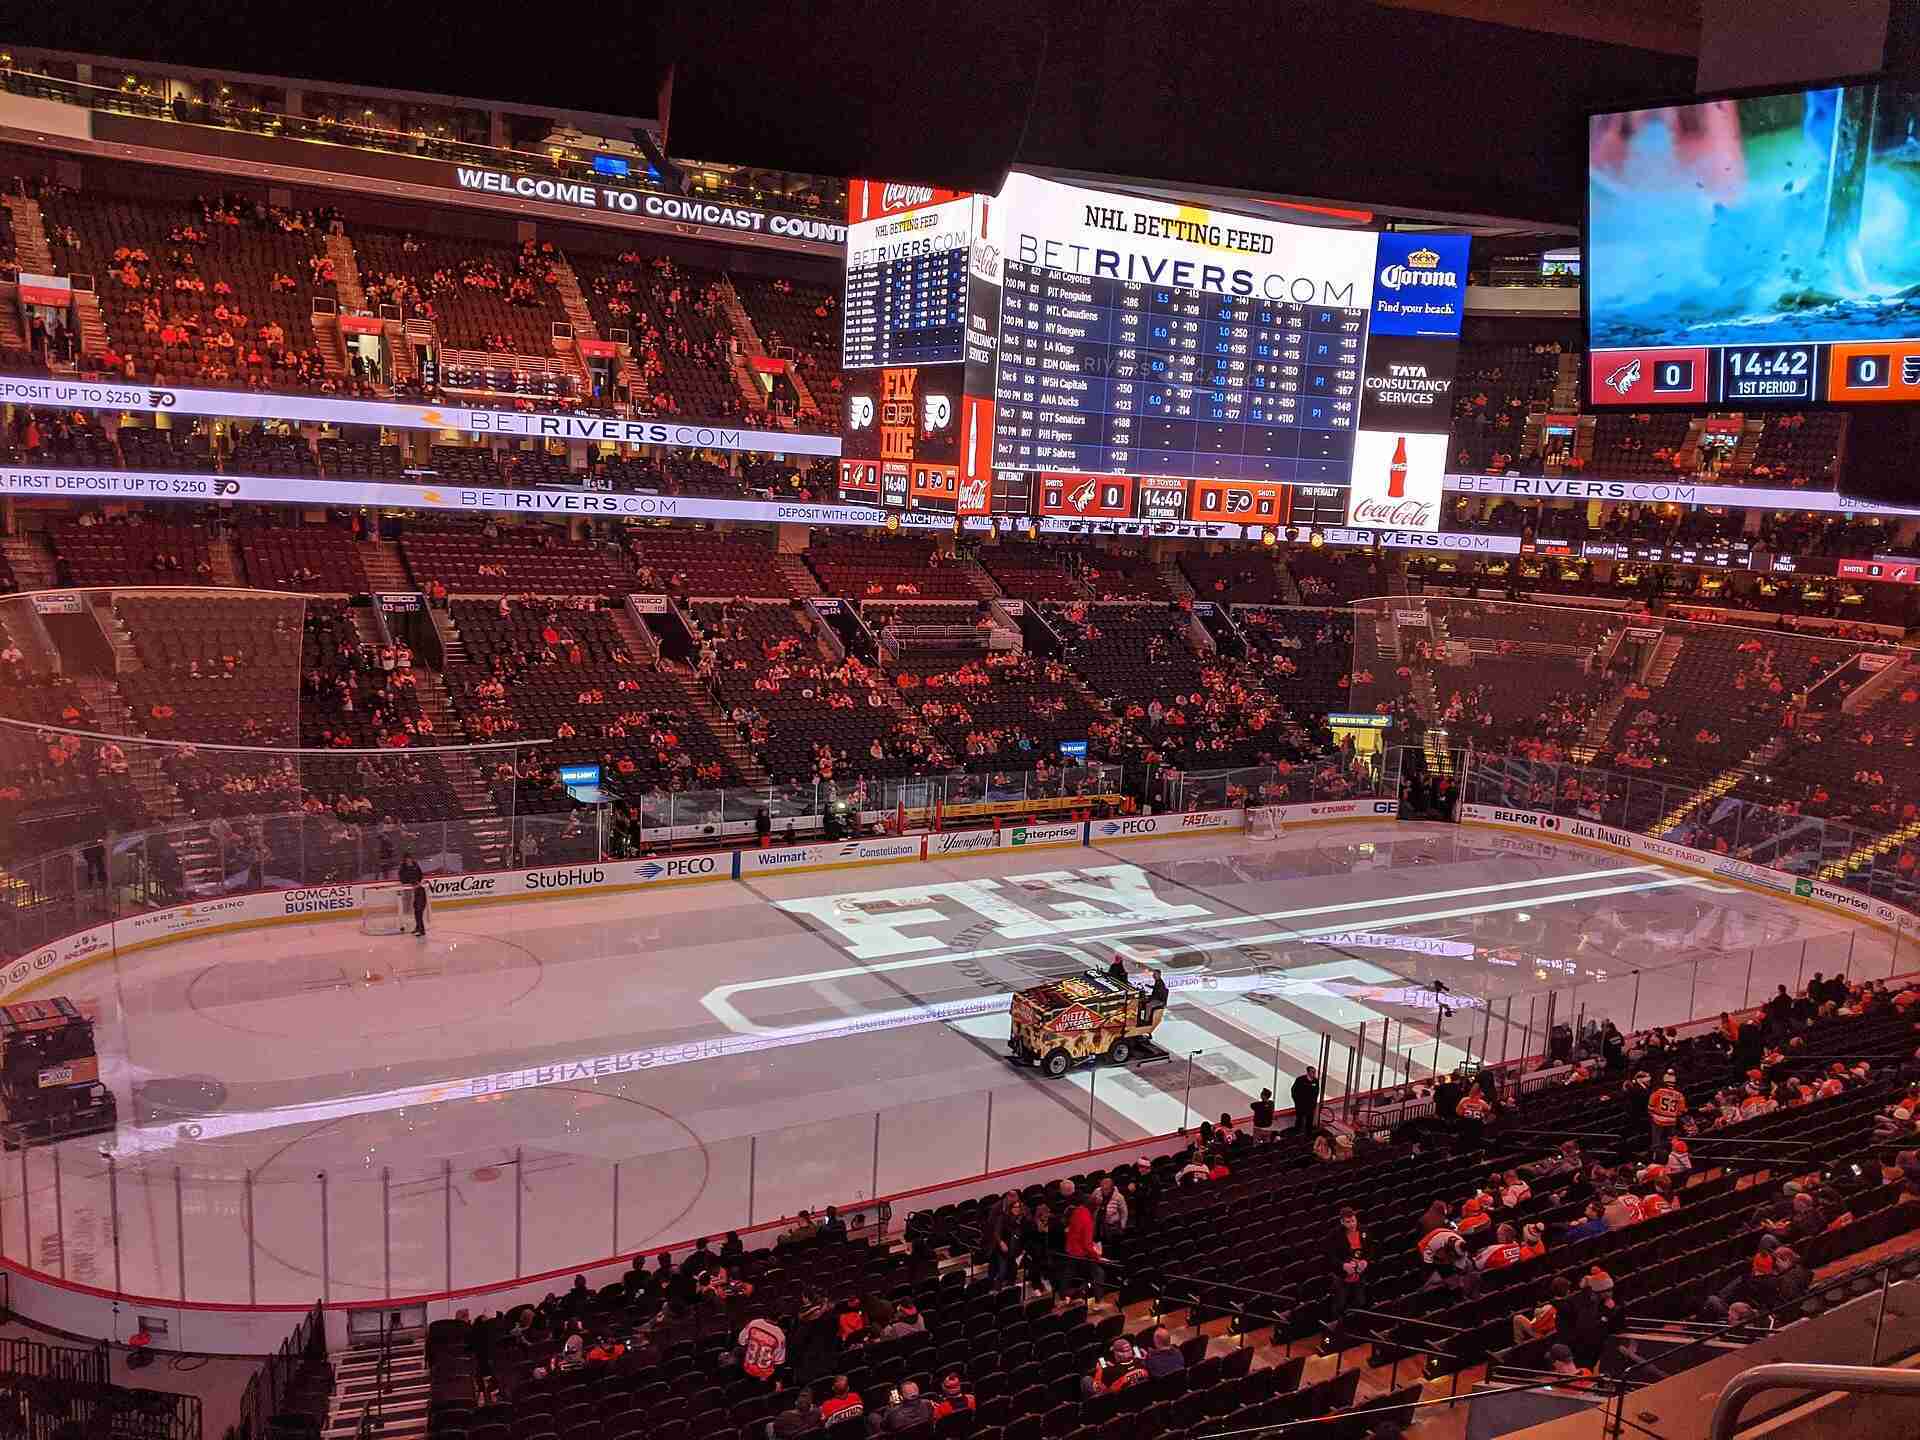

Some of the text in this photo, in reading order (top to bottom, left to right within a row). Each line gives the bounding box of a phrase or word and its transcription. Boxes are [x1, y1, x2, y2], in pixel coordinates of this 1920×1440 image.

[456, 168, 596, 206] WELCOME
[603, 190, 639, 210] TO
[645, 196, 765, 229] COMCAST
[875, 213, 938, 237] NHL BETTING FEED
[1085, 205, 1274, 255] NHL BETTING FEED
[853, 231, 967, 266] BETRIVERS.COM
[1019, 233, 1354, 306] BETRIVERS.COM
[1380, 264, 1457, 291] Corona
[1060, 289, 1092, 303] Penguins
[1062, 307, 1098, 321] Canadiens
[1377, 300, 1399, 313] Find
[1401, 305, 1423, 316] your
[973, 314, 987, 331] TATA
[1056, 324, 1086, 338] Rangers
[1044, 341, 1054, 351] LA
[1055, 343, 1075, 355] Kings
[1389, 365, 1427, 378] TATA
[1730, 351, 1808, 377] 14:42
[1860, 360, 1876, 382] 0
[1666, 365, 1680, 386] 0
[1059, 378, 1088, 390] Capitals
[1365, 377, 1451, 392] CONSULTANCY
[1737, 381, 1797, 395] 1ST PERIOD
[55, 387, 77, 400] UP
[80, 389, 102, 401] TO
[106, 390, 141, 405] $250
[1040, 394, 1057, 405] ANA
[1058, 396, 1079, 407] Ducks
[1378, 391, 1434, 404] SERVICES
[1040, 412, 1054, 422] OTT
[1055, 413, 1086, 425] Senators
[470, 411, 742, 448] BETRIVERS.COM
[1051, 430, 1072, 442] Flyers
[1052, 448, 1076, 459] Sabres
[9, 474, 207, 494] FIRST DEPOSIT UP TO $250
[885, 475, 907, 492] 14:40
[918, 471, 925, 488] 0
[947, 479, 953, 490] 0
[1045, 479, 1063, 487] SHOTS
[1108, 487, 1118, 505] 0
[1313, 487, 1339, 497] PENALTY
[1458, 475, 1696, 502] BETRIVERS.COM
[460, 491, 678, 514] BETRIVERS.COM
[1050, 491, 1057, 505] 0
[1144, 491, 1182, 507] 14:40
[1206, 492, 1215, 509] 0
[778, 507, 820, 519] DEPOSIT
[822, 510, 848, 521] WITH
[851, 511, 878, 522] CODE
[1261, 502, 1268, 512] 0
[1872, 566, 1879, 575] 0
[1494, 811, 1537, 825] BELFOR
[1015, 825, 1077, 843] enterprise
[1122, 818, 1156, 835] PECO
[1571, 821, 1595, 839] JACK
[939, 832, 991, 851] Yuengling
[758, 849, 808, 866] Walmart
[860, 843, 913, 858] Constellation
[1642, 840, 1706, 864] WELLS FARGO
[666, 856, 714, 877] PECO
[525, 867, 605, 889] StubHub
[284, 886, 352, 902] COMCAST
[1797, 878, 1868, 911] enterprise
[134, 900, 245, 928] RIVERS CASINO
[285, 900, 353, 914] BUSINESS
[37, 953, 53, 967] KIA
[11, 965, 27, 979] KIA
[1660, 1098, 1677, 1112] 53
